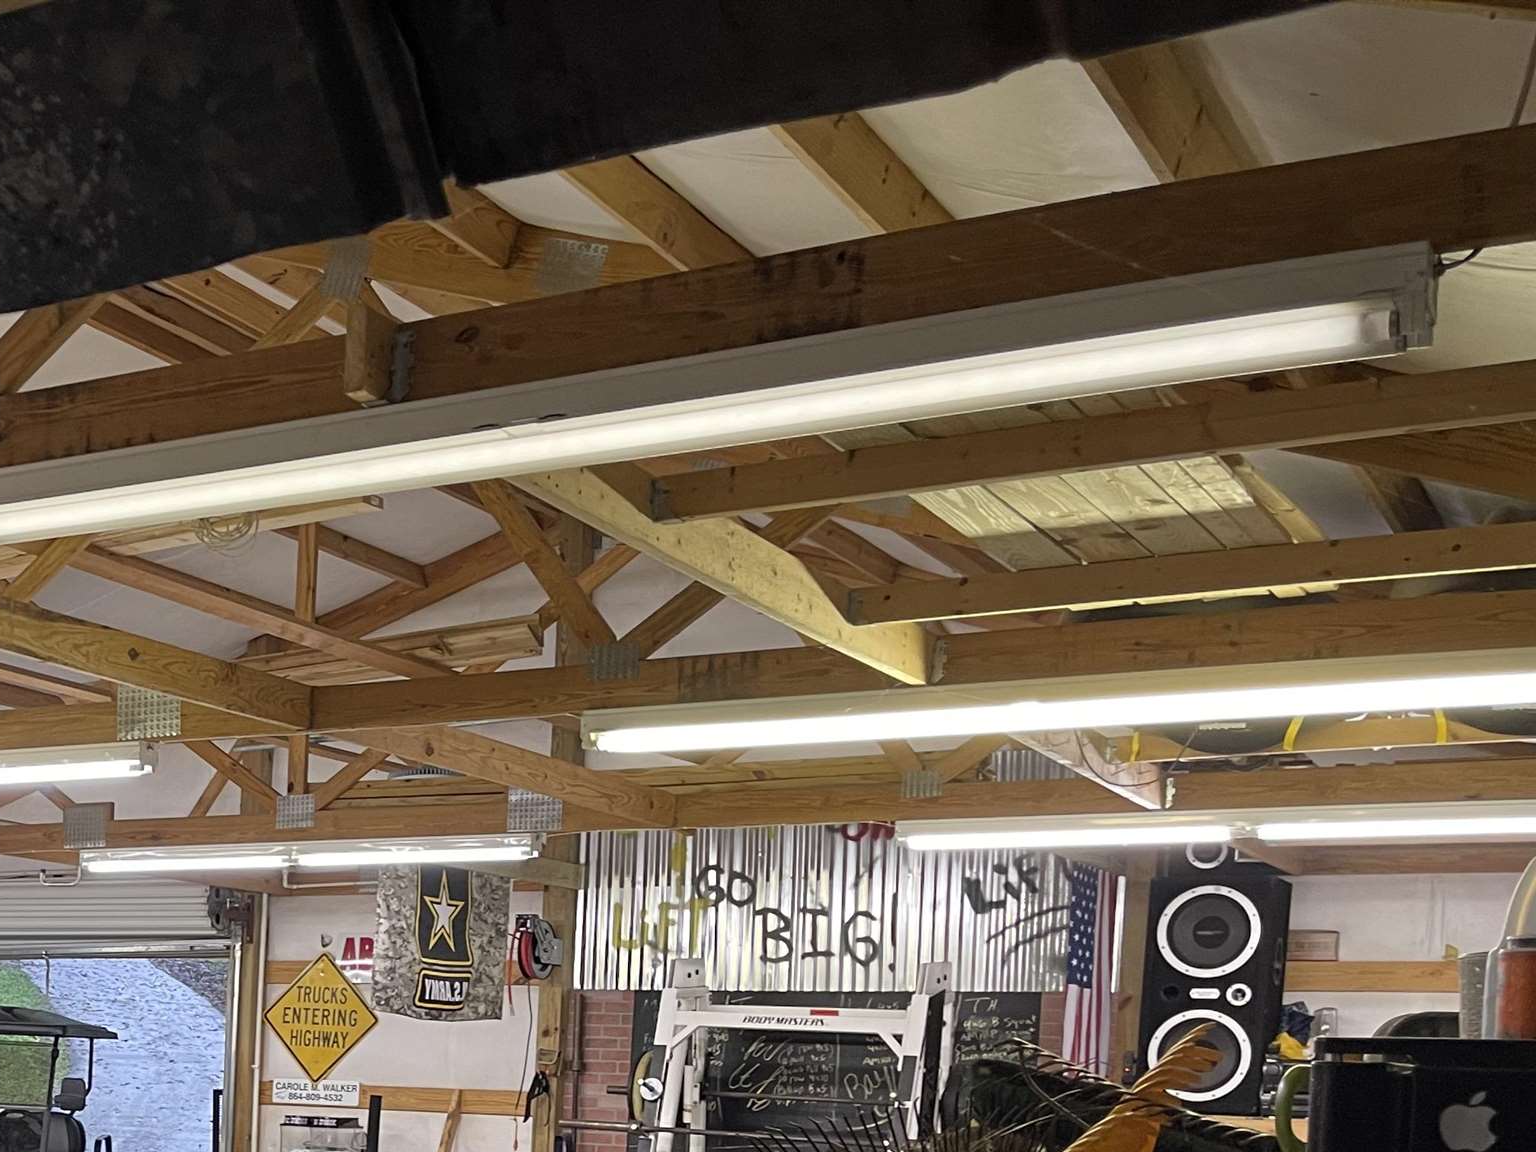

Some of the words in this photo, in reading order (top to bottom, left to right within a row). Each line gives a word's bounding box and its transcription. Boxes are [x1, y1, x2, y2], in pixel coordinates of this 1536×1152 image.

[296, 985, 349, 1005] TRUCKS
[282, 1007, 359, 1027] ENTERING
[290, 1029, 349, 1049] HIGHWAY
[275, 1082, 309, 1091] CAROLE
[322, 1083, 358, 1093] WALKER
